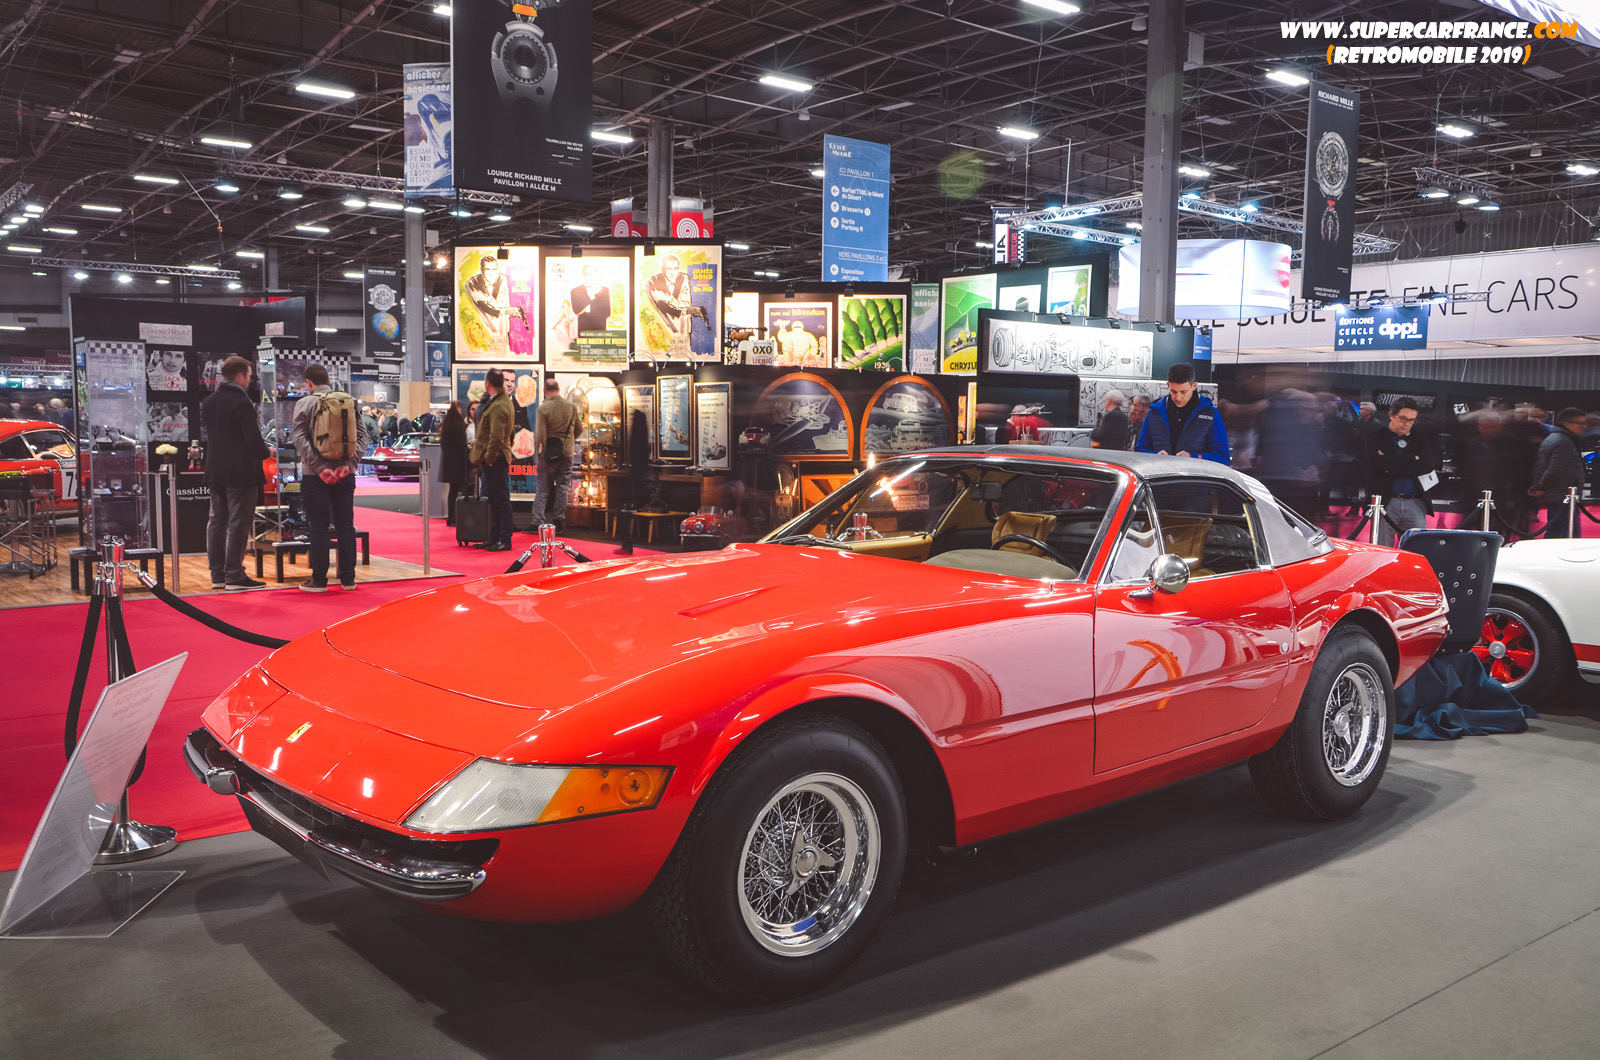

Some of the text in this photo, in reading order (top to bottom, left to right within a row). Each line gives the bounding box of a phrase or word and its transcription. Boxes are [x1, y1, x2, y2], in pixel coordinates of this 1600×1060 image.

[406, 70, 440, 80] affiches
[406, 83, 450, 93] anciennes
[1318, 90, 1339, 102] RICHARD
[1340, 97, 1354, 107] MILLE
[487, 169, 562, 185] LOUNGE RICHARD MILLE
[847, 168, 870, 177] PAVILLON
[494, 178, 524, 187] PAVILLON
[529, 182, 549, 191] ALLÉE
[842, 205, 863, 213] Brasserie
[841, 224, 859, 232] Parking
[851, 252, 875, 261] PAVILLONS
[841, 267, 864, 275] Exposition
[1487, 275, 1578, 313] CARS
[792, 308, 825, 316] bibendum
[1339, 317, 1374, 325] ÉDITIONS
[141, 327, 190, 336] ClassicHeuer
[1339, 327, 1374, 336] CERCLE
[1379, 317, 1418, 339] dppi
[752, 346, 772, 354] OXO
